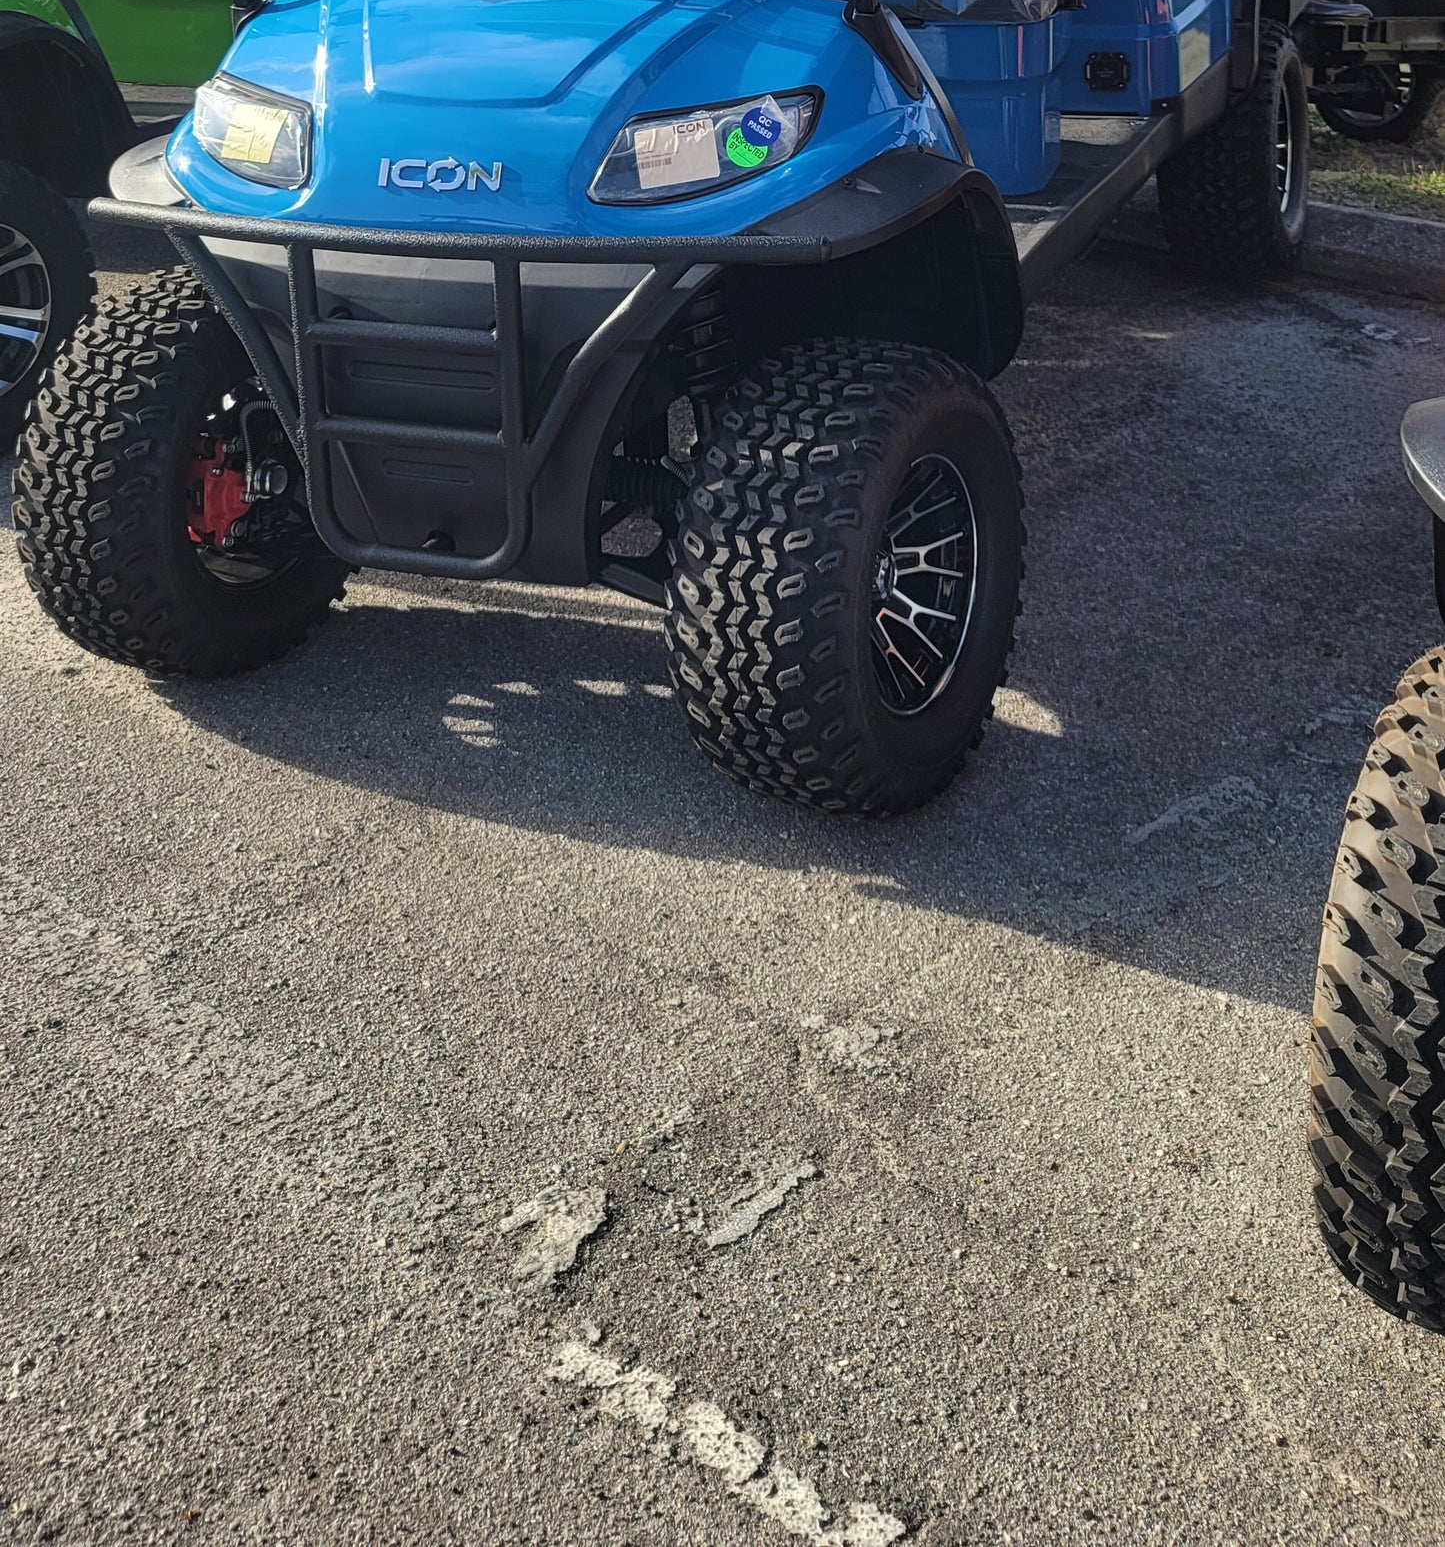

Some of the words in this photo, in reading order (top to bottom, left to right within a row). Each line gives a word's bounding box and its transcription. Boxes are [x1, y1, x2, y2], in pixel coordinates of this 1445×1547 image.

[672, 120, 706, 135] ICON
[758, 115, 772, 127] QC
[747, 120, 773, 139] PASSED
[728, 141, 740, 151] BY
[377, 155, 503, 193] ICON
